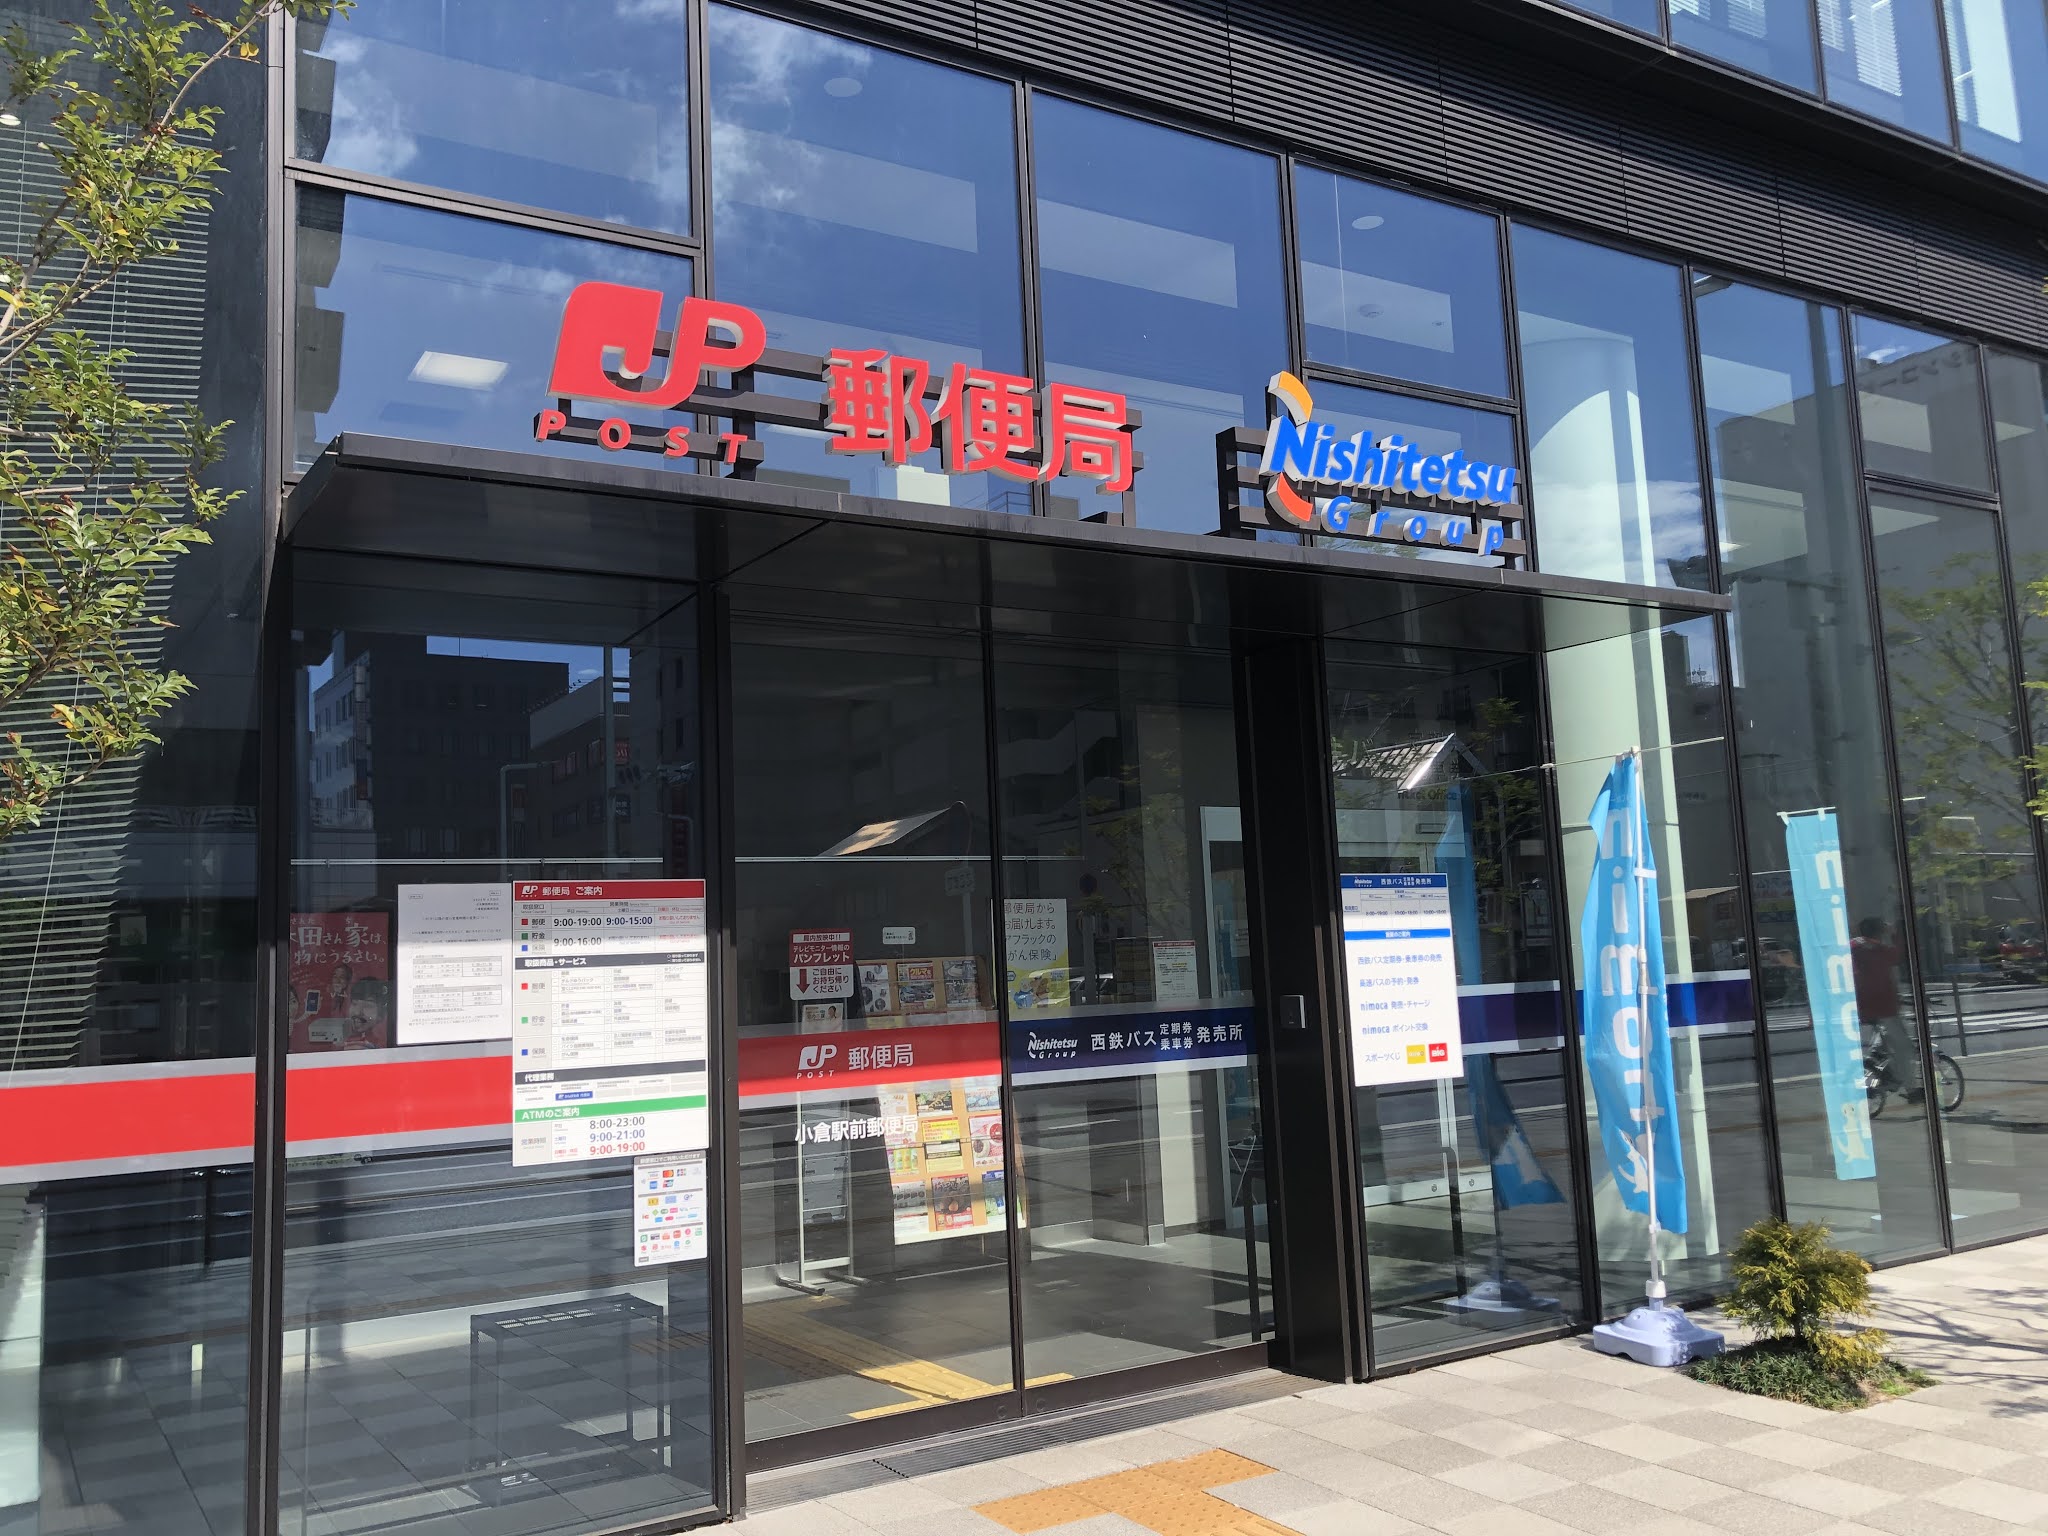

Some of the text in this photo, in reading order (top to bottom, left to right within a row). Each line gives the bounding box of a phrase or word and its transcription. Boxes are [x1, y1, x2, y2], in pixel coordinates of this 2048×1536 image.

[547, 281, 766, 408] JP
[825, 348, 1135, 495] 郵便局
[535, 408, 750, 464] POST
[1260, 415, 1517, 505] Nishitetsu
[1320, 495, 1505, 557] Group
[542, 886, 603, 896] 郵便局 ご案内
[531, 918, 546, 926] 郵便
[553, 917, 602, 927] 9:00-19:00
[606, 916, 653, 926] 9:00-15:00
[531, 932, 546, 940] 貯金
[553, 937, 602, 947] 9:00-16:00
[793, 944, 850, 953] テレビモニター情報の
[793, 952, 851, 964] パンフレット
[812, 968, 843, 976] ご自由に
[812, 975, 850, 985] お持ち帰り
[812, 984, 843, 993] ください
[1360, 1002, 1388, 1012] nimoca
[1159, 1022, 1193, 1036] 定期券
[1196, 1023, 1244, 1044] 発売所
[1362, 1022, 1429, 1035] nimoca ポイント交換
[1027, 1037, 1078, 1051] Nishitetsu
[1090, 1030, 1158, 1052] 西鉄バス
[1160, 1037, 1194, 1051] 乗車券
[798, 1044, 838, 1070] JP
[848, 1043, 914, 1071] 郵便局
[1038, 1050, 1077, 1060] Group
[796, 1069, 835, 1080] POST
[521, 1107, 580, 1120] ATMのご案内
[589, 1116, 645, 1130] 8:00-23:00
[589, 1129, 646, 1143] 9:00-21:00
[794, 1114, 919, 1146] 小倉駅前郵便局
[589, 1142, 646, 1156] 9:00-19:00
